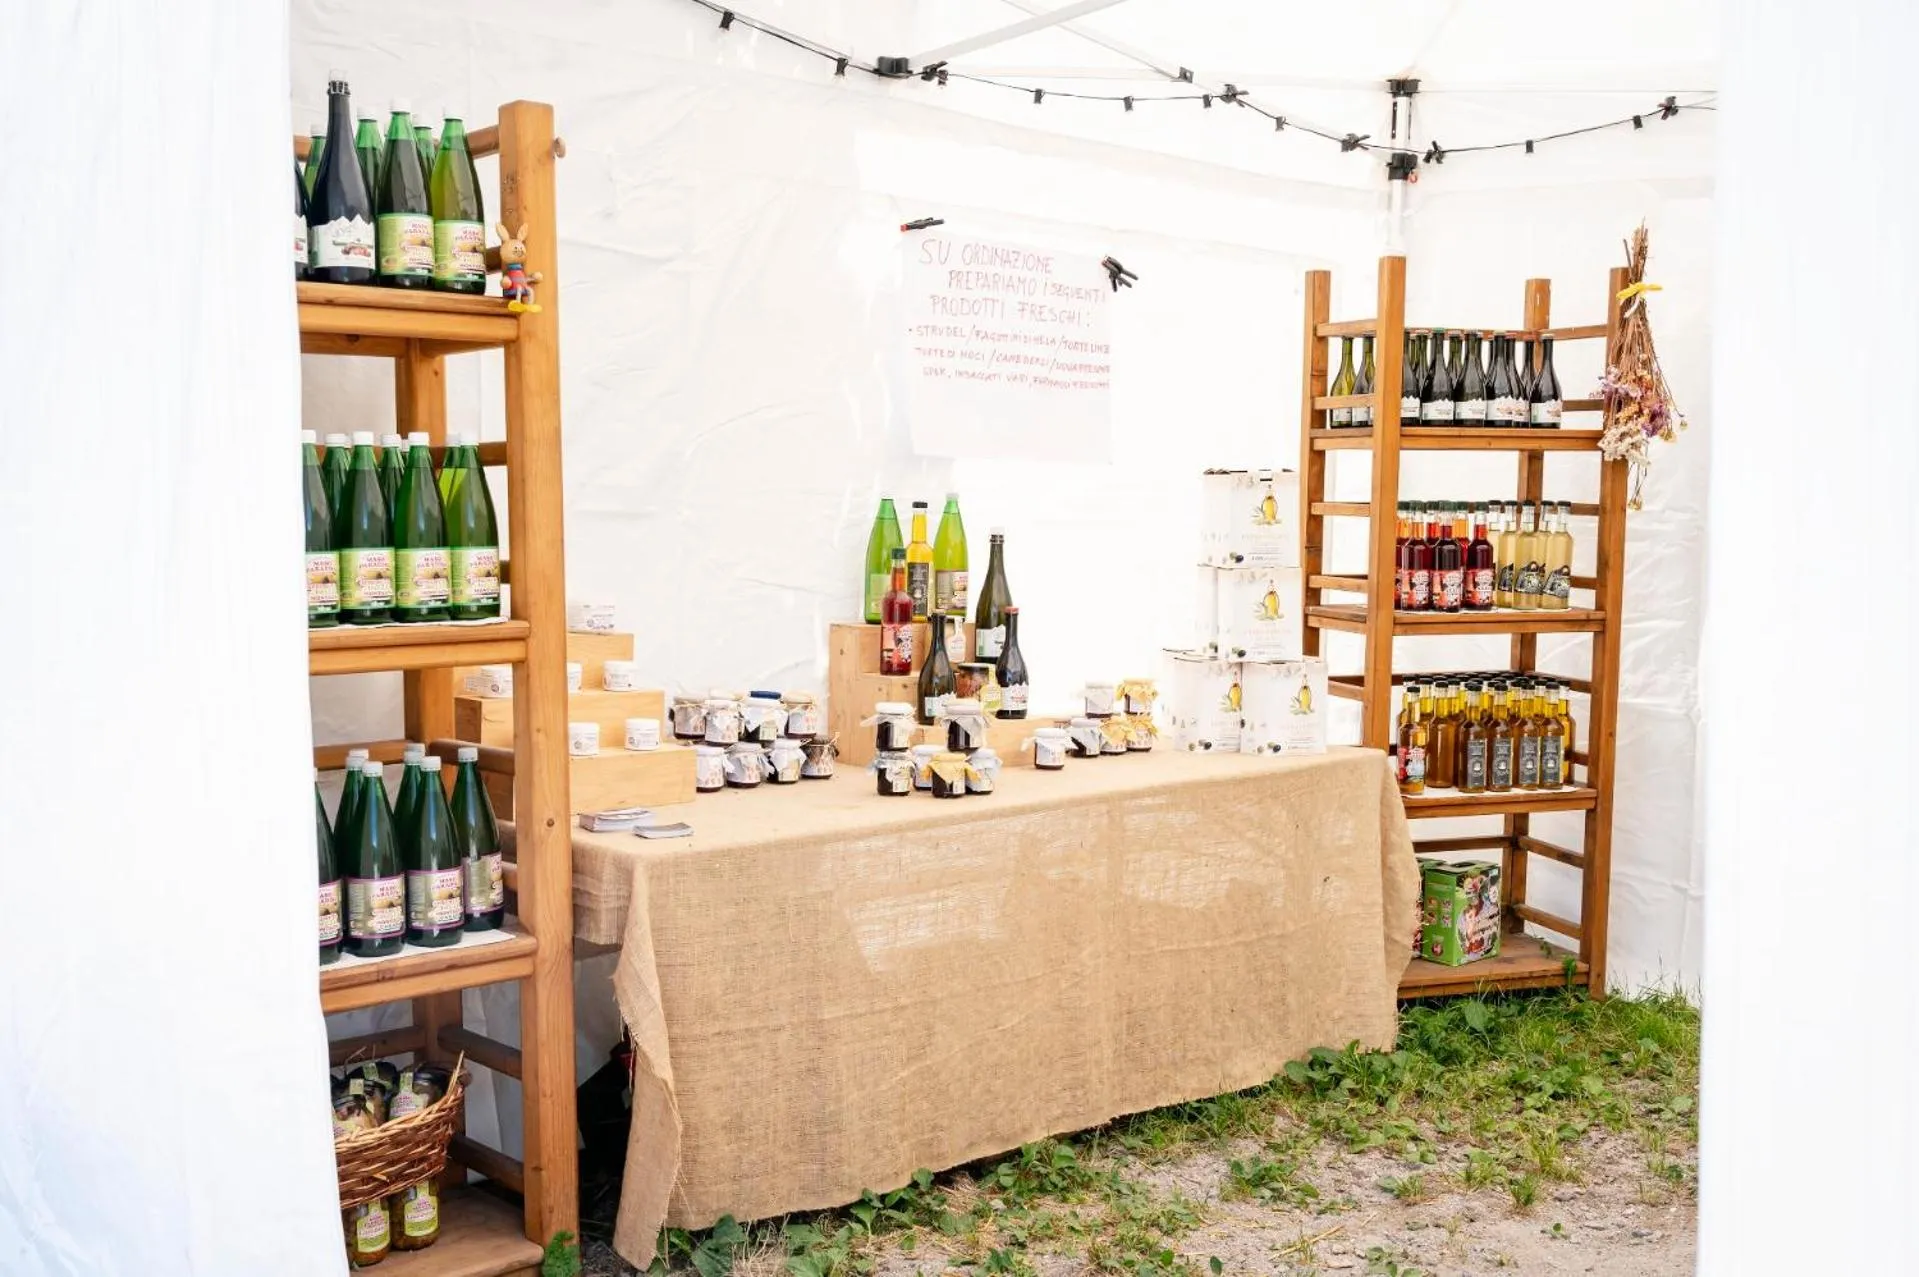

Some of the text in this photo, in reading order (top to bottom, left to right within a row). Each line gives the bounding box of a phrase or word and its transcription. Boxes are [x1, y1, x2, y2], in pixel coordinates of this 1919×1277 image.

[918, 239, 1055, 274] SU ORDINAZIONE
[948, 269, 1037, 297] PREPARIAMO
[1050, 282, 1106, 304] SEGUENTI
[929, 294, 1005, 320] PRODOTTI
